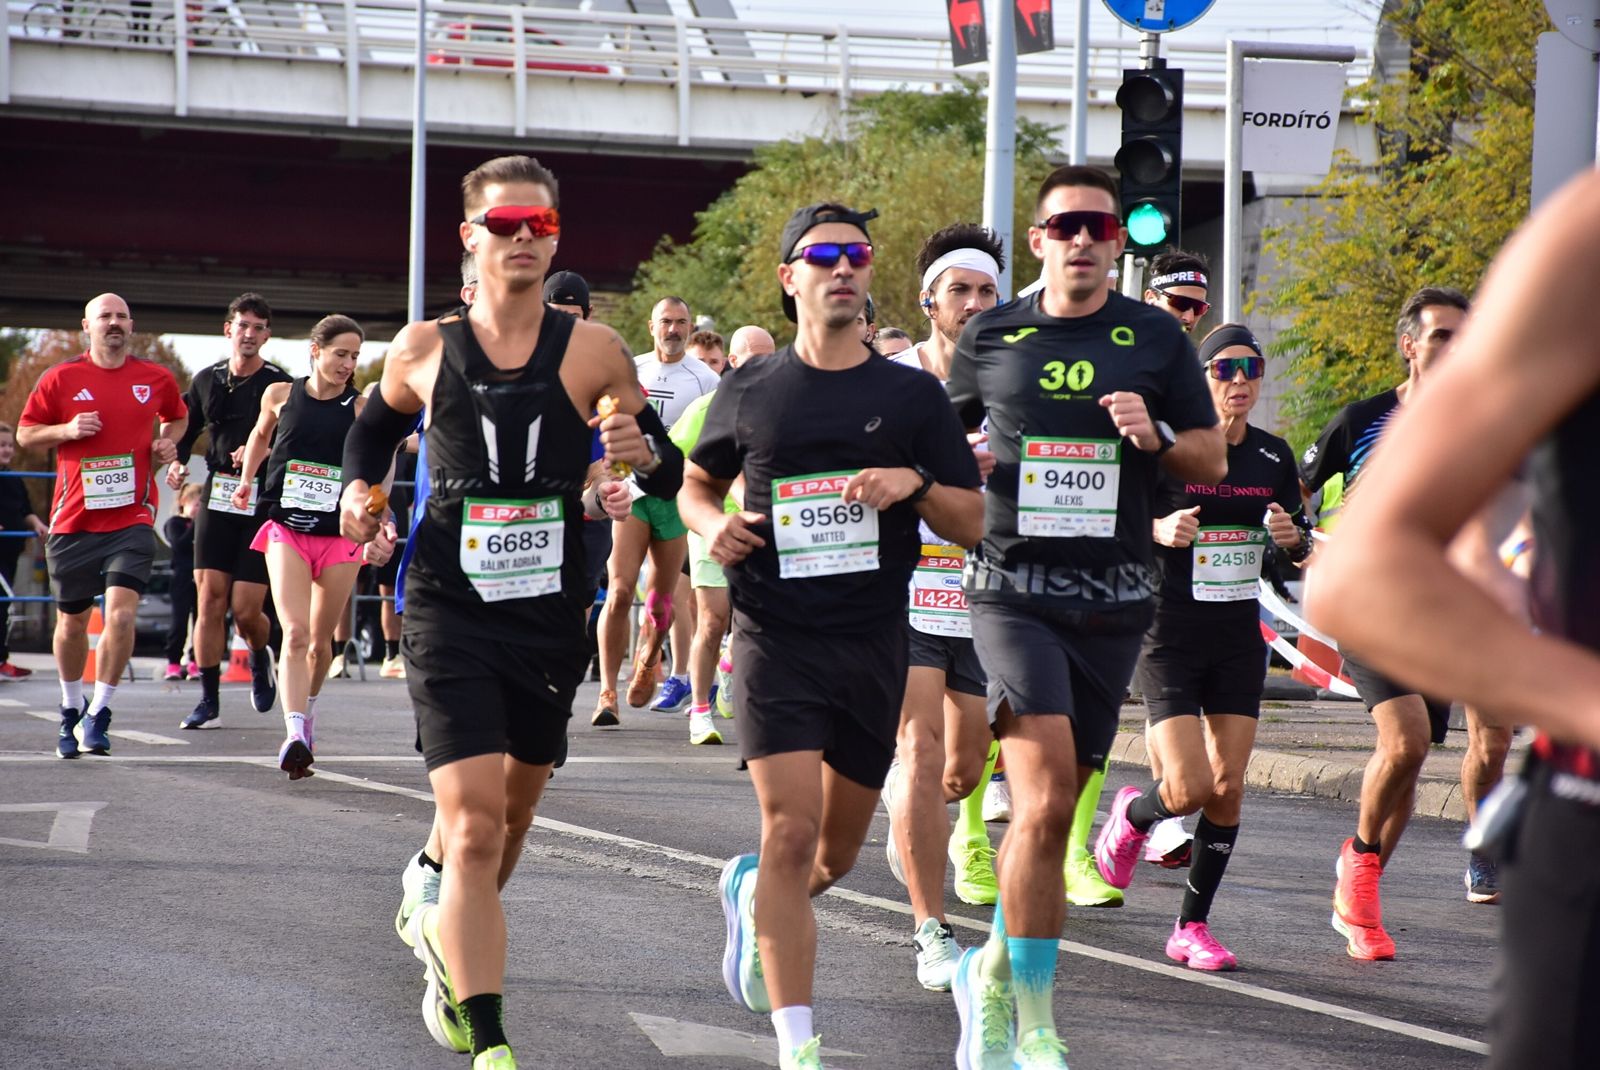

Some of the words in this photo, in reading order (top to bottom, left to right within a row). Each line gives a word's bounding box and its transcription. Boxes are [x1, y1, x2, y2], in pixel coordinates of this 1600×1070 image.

[1242, 110, 1331, 129] FORDÍTÓ
[1039, 360, 1095, 391] 30
[1039, 444, 1095, 456] SPAR
[90, 459, 121, 469] SPAR
[297, 465, 328, 477] SPAR
[95, 472, 129, 485] 6038
[1044, 469, 1105, 490] 9400
[223, 482, 242, 493] 83
[299, 479, 332, 494] 7435
[791, 479, 848, 496] SPAR
[1185, 484, 1217, 495] INTESA
[1054, 495, 1084, 506] ALEXIS
[482, 505, 536, 519] SPAR
[781, 515, 790, 526] 2
[800, 503, 864, 528] 9569
[468, 538, 476, 550] 2
[487, 530, 549, 554] 6683
[811, 531, 846, 544] MATTEO
[1208, 531, 1248, 541] SPAR
[480, 557, 510, 571] BÁLINT
[512, 554, 542, 569] ADRIÁN
[928, 557, 965, 568] SPA
[1212, 552, 1256, 567] 24518
